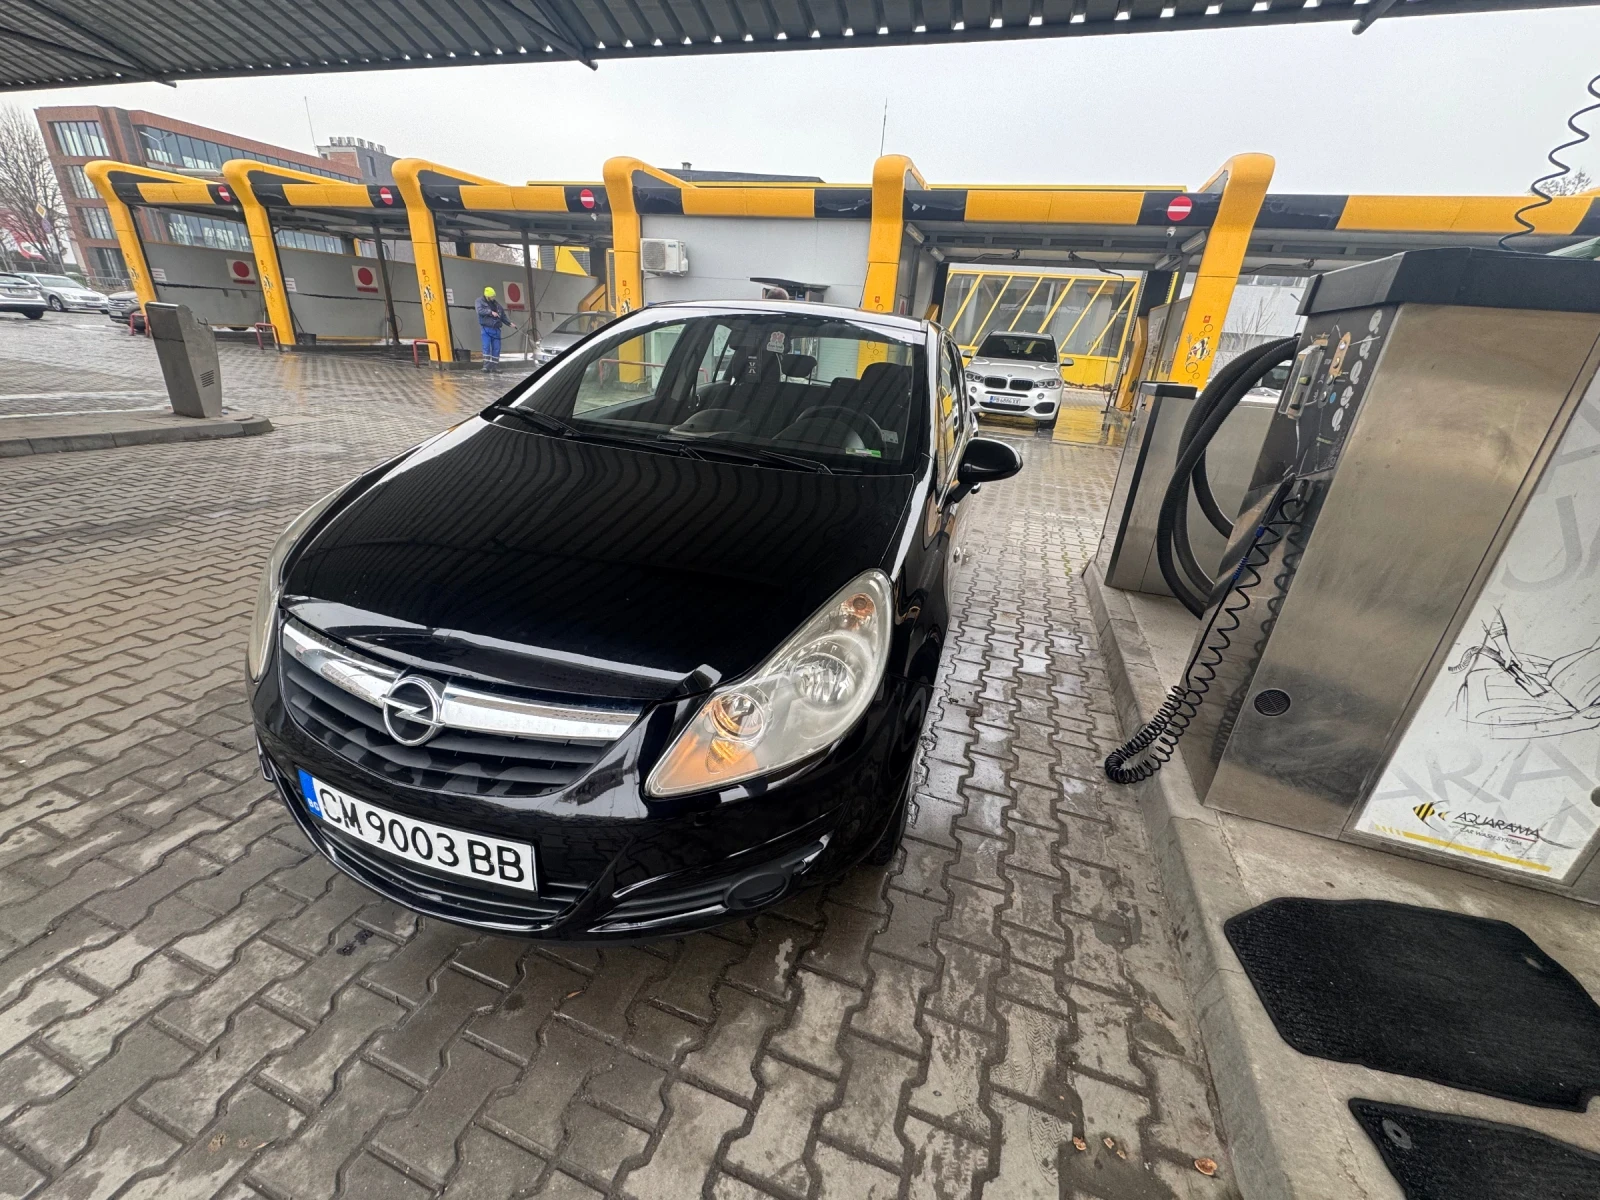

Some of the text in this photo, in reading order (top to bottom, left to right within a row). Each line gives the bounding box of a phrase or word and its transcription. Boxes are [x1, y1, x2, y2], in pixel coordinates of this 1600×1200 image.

[307, 797, 321, 812] BG
[1454, 811, 1540, 839] AQUARAMA
[365, 811, 460, 867] 9003
[467, 839, 525, 883] BB
[1475, 831, 1496, 840] WASH
[1496, 836, 1522, 846] SYSTEM
